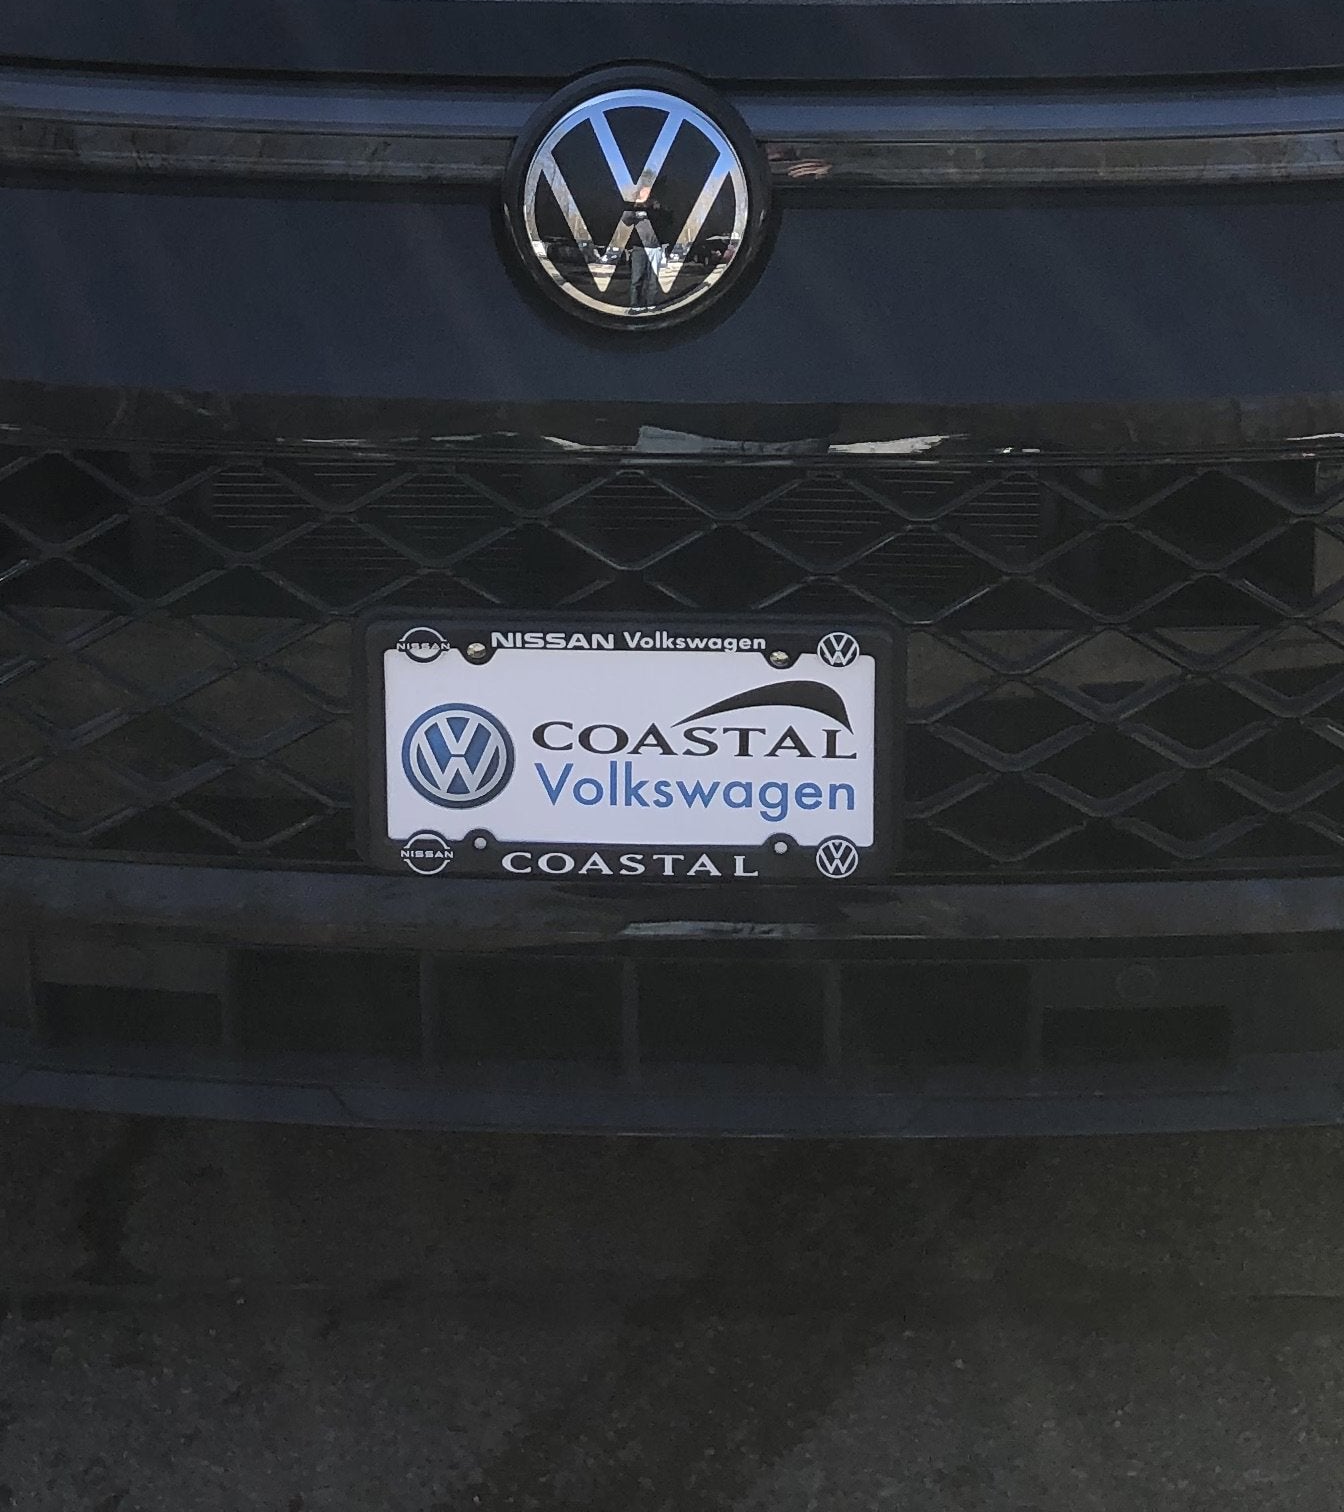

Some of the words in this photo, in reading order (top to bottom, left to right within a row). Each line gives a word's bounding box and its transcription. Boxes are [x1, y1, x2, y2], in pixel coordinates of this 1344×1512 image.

[490, 631, 615, 650] NISSAN
[623, 631, 767, 653] Volkswagen
[532, 720, 858, 760] COASTAL
[534, 760, 856, 822] Volkswagen
[501, 851, 759, 877] COASTAL
